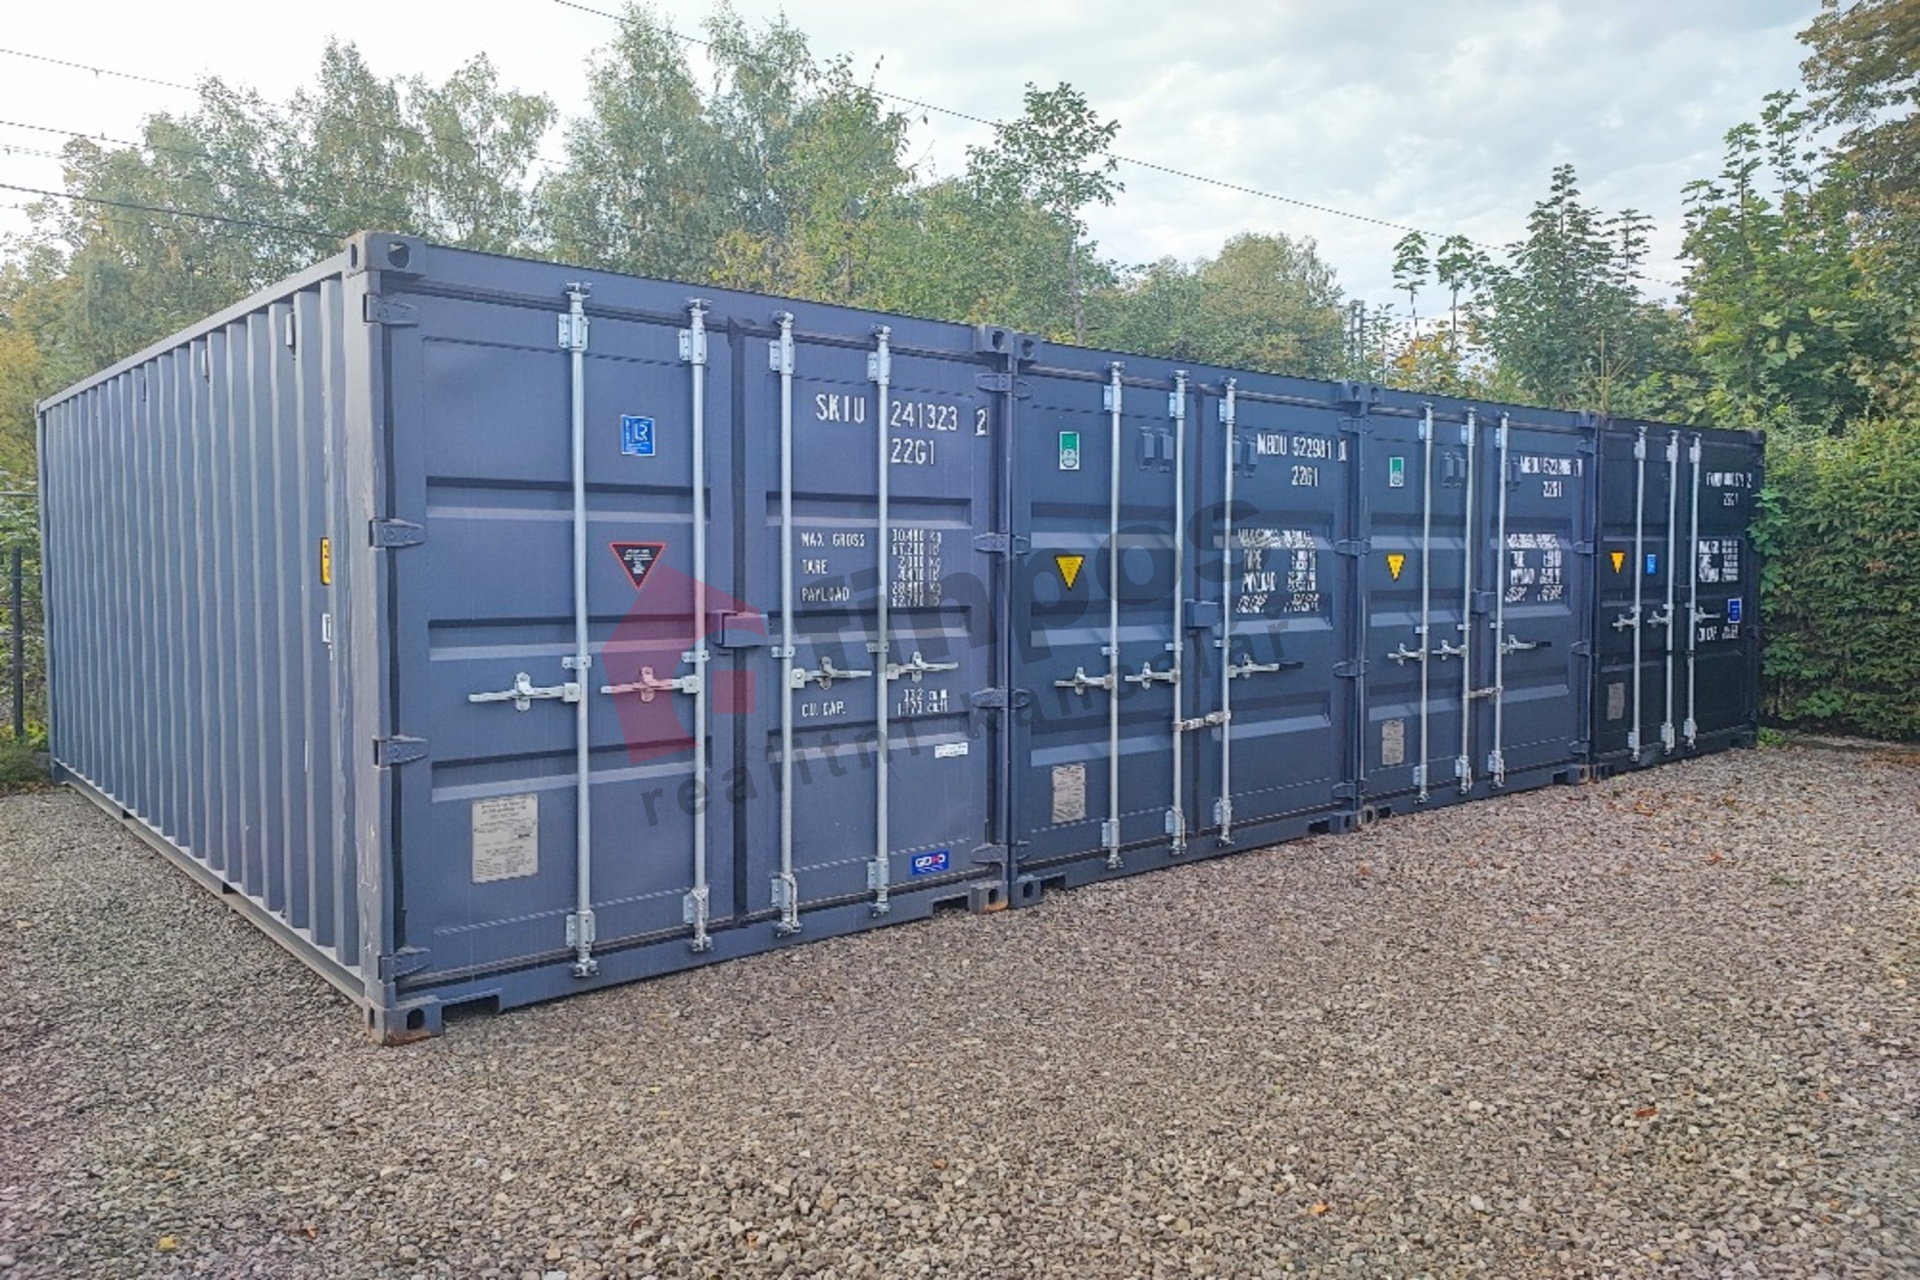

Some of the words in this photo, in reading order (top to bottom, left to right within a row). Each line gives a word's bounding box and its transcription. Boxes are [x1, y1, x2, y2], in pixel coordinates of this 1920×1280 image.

[815, 394, 865, 423] SKIU
[891, 401, 957, 431] 241323
[975, 408, 988, 436] 2
[891, 438, 935, 465] 22G1
[801, 532, 825, 547] MAX
[832, 533, 865, 547] GROSS
[802, 559, 828, 574] TARE
[802, 586, 850, 602] PAYLOAD
